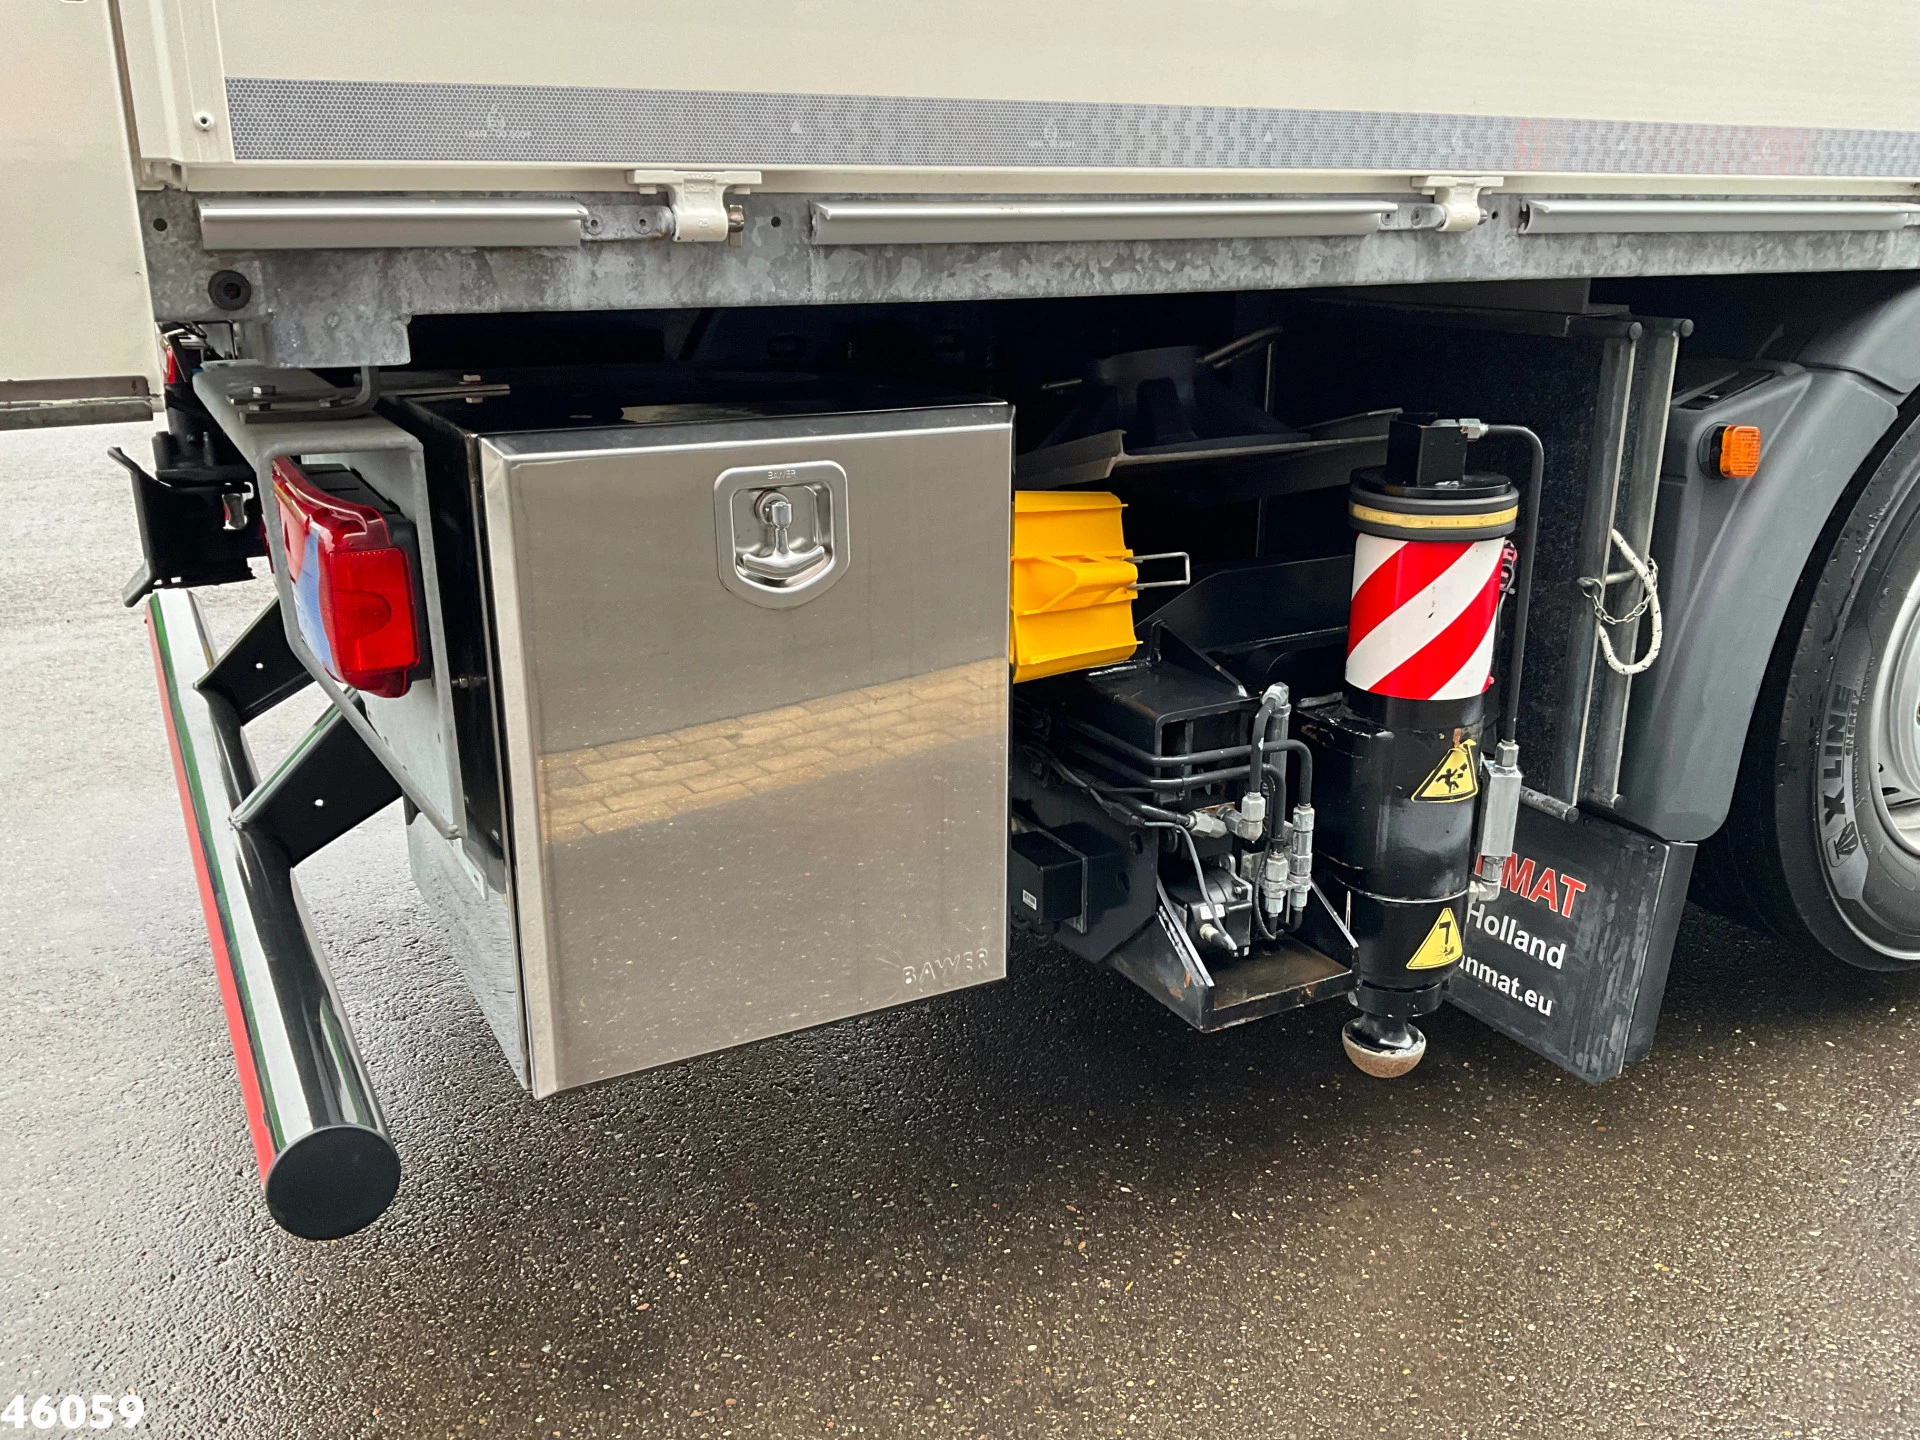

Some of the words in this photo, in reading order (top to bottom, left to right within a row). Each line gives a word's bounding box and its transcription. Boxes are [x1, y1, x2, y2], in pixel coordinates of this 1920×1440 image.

[767, 468, 797, 480] BAWER
[1823, 684, 1854, 780] LINE
[1466, 901, 1567, 970] Holland
[902, 948, 989, 985] BAWER
